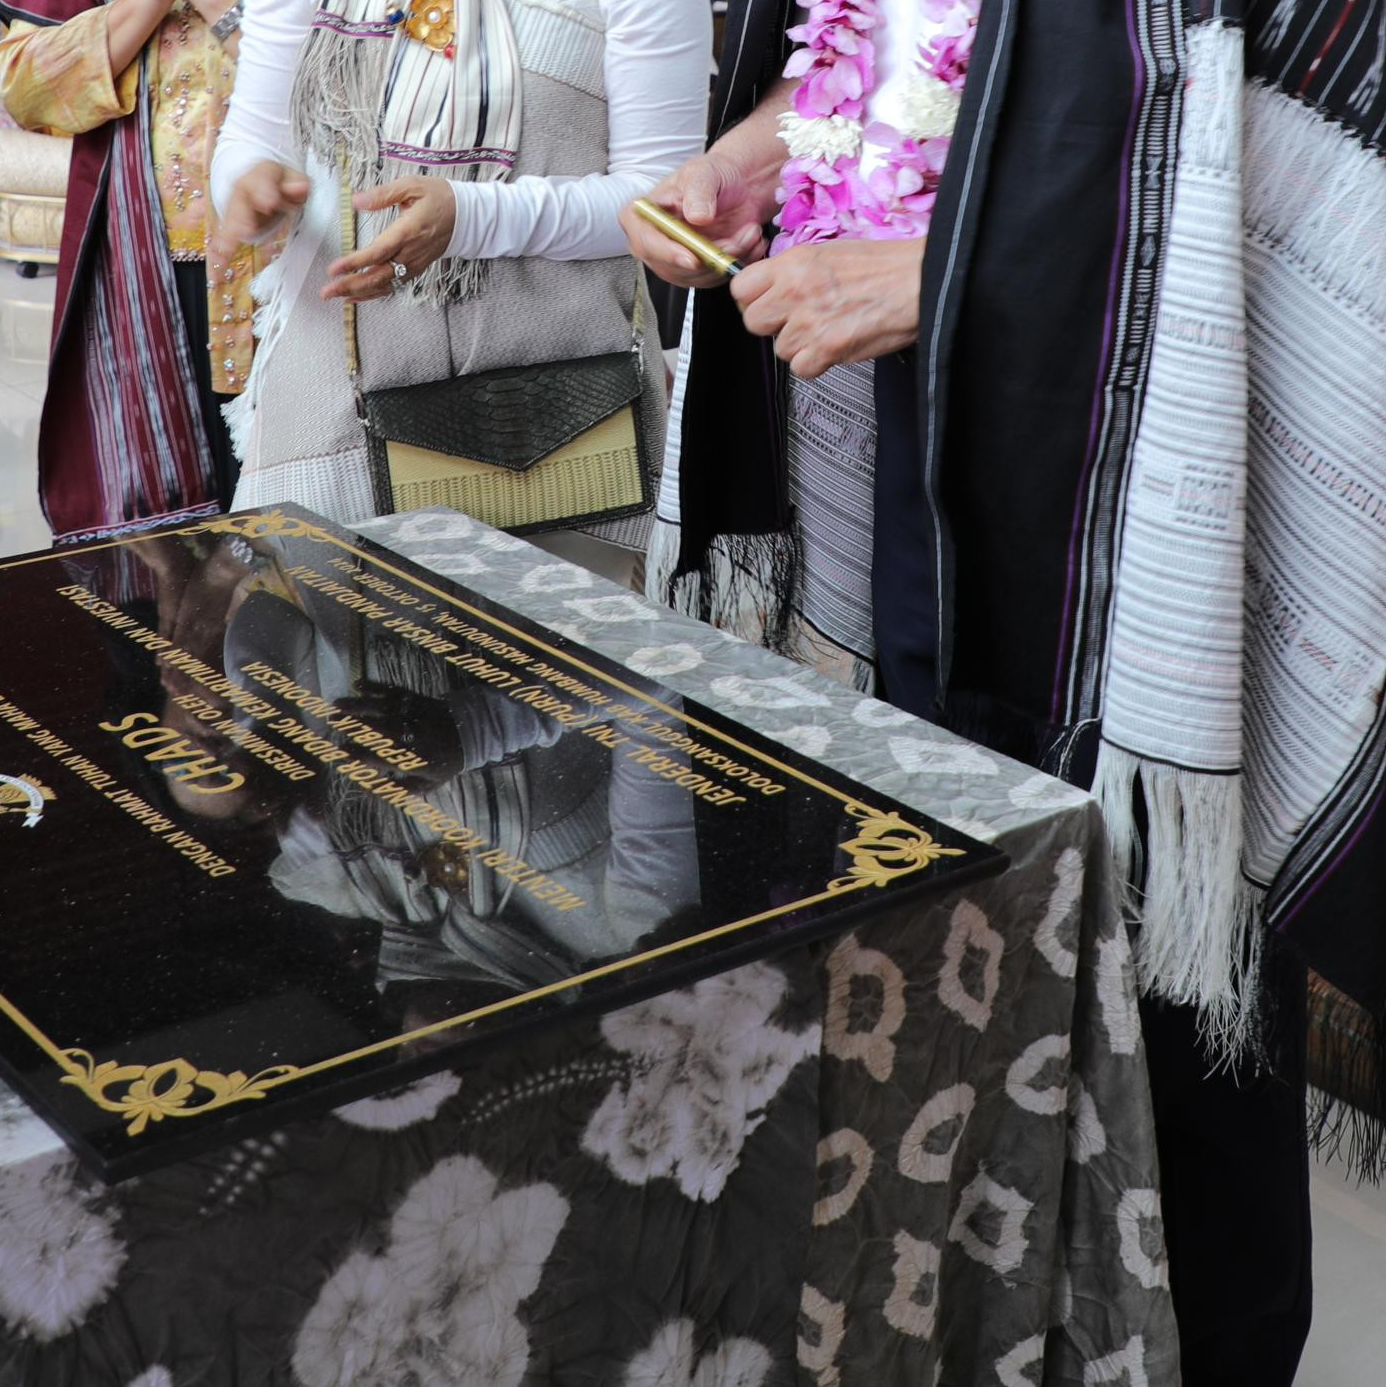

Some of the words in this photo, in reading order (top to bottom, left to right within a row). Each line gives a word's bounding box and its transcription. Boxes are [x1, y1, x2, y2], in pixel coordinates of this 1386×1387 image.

[53, 583, 140, 629] INVESTASI
[281, 564, 394, 619] PANDJAITAN
[352, 572, 421, 606] OKTOBER
[122, 627, 174, 650] DAN
[379, 616, 460, 654] BINSAR
[155, 648, 283, 719] KEMARITIMAN
[235, 660, 342, 718] INDONESIA
[443, 650, 524, 688] LUHUT
[522, 661, 615, 706] HUMBANG
[169, 692, 226, 721] OLEH
[504, 682, 605, 728] (PURN)
[601, 702, 651, 724] KAB
[25, 728, 76, 756] YANG
[95, 710, 253, 798] CHADS
[208, 718, 317, 781] DIRESMIKAN
[265, 717, 350, 762] BIDANG
[324, 714, 430, 771] REPUBLIK
[579, 723, 634, 747] TNI
[639, 720, 789, 796] DOLOKSANGGUL
[58, 754, 121, 789] TUHAN
[618, 743, 749, 808] JENDERAL
[103, 786, 179, 832] RAHMAT
[333, 760, 489, 850] KOORDINATOR
[159, 830, 238, 877] DENGAN
[472, 847, 589, 912] MENTERI
